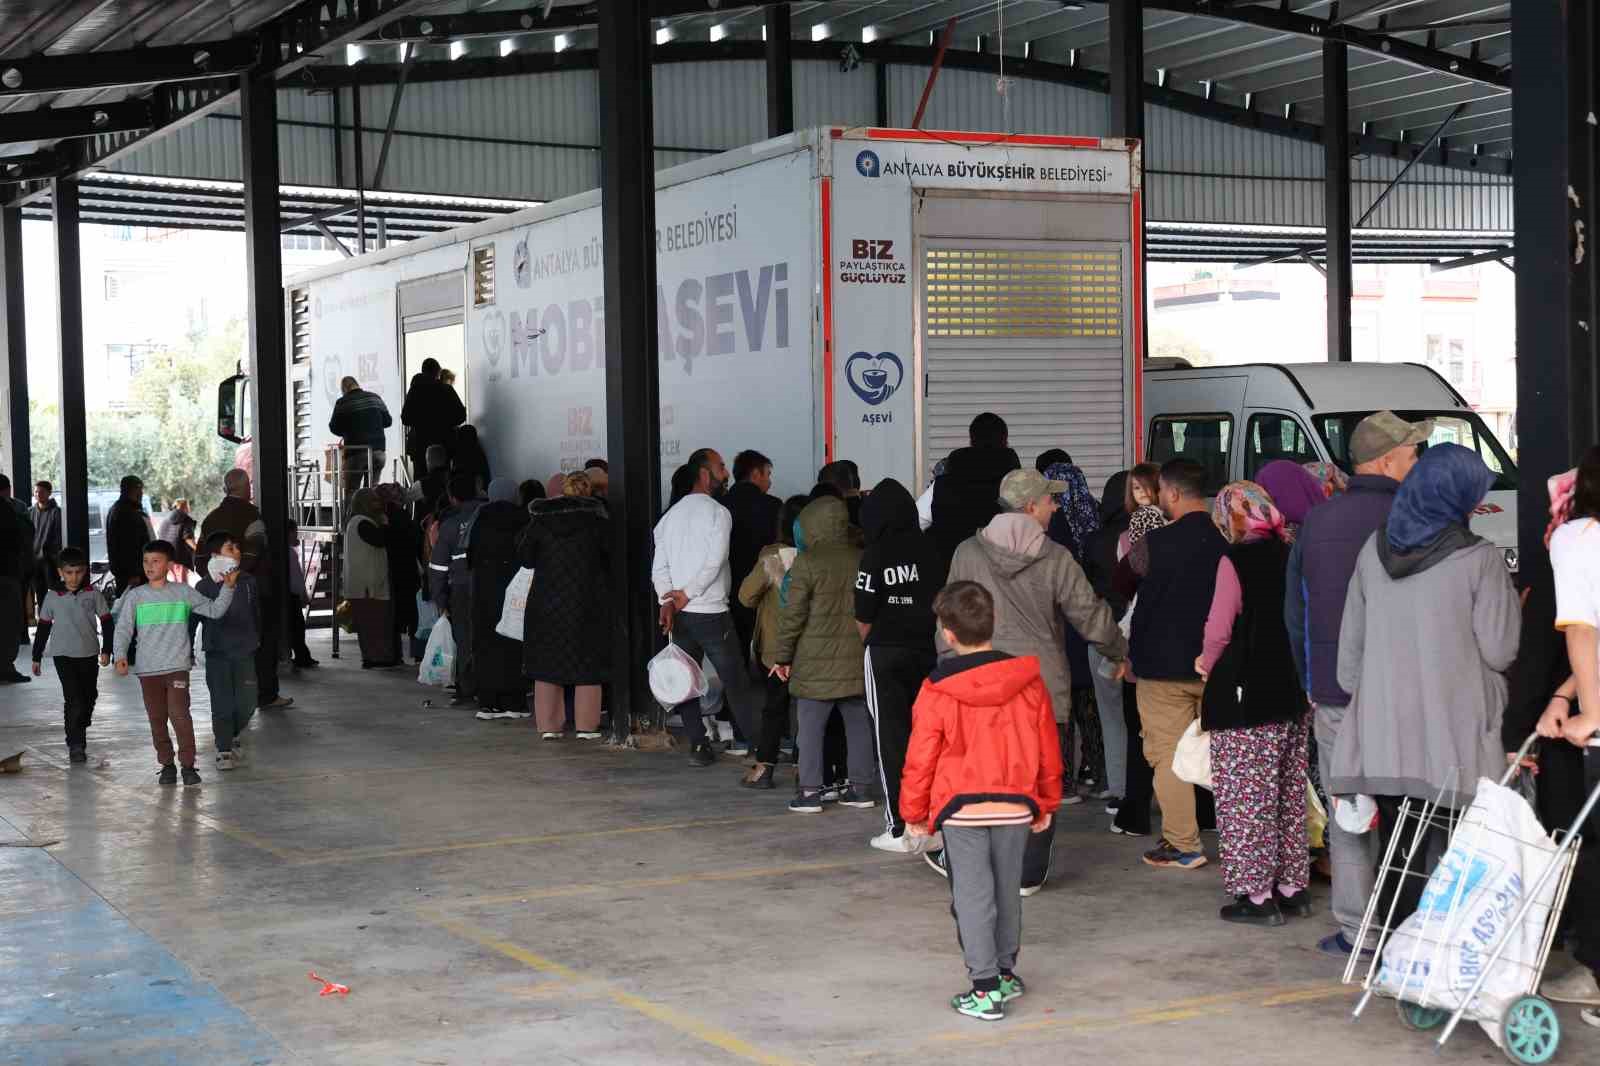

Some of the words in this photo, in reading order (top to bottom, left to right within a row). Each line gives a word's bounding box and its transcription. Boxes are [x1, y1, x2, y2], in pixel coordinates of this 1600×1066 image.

[883, 162, 944, 177] ANTALYA
[947, 161, 1036, 181] BÜYÜKŞEHİR
[1040, 165, 1107, 182] BELEDİYESİ
[533, 247, 581, 281] ANTALYA
[666, 202, 737, 253] BELEDİYESİ
[839, 261, 905, 271] PAYLAŞTIKÇA
[840, 272, 906, 284] GÜÇLÜYÜZ
[862, 411, 892, 425] AŞEVİ
